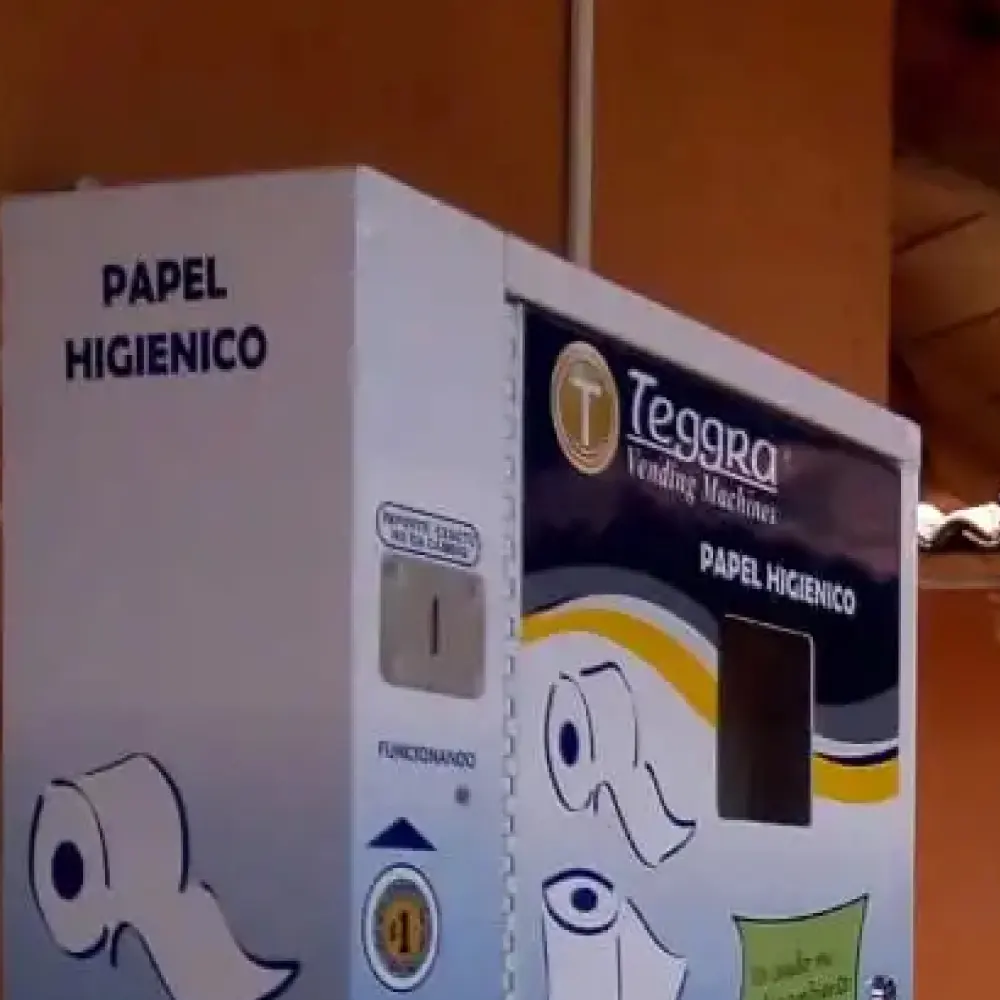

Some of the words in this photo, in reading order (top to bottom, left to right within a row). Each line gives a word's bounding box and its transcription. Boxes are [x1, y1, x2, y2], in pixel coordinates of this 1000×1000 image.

[101, 254, 228, 306] PAPEL
[64, 324, 268, 380] HIGIENICO
[627, 446, 697, 506] Vending
[703, 473, 780, 525] Machines
[699, 541, 762, 589] PAPEL
[766, 561, 856, 616] HIGIENICO
